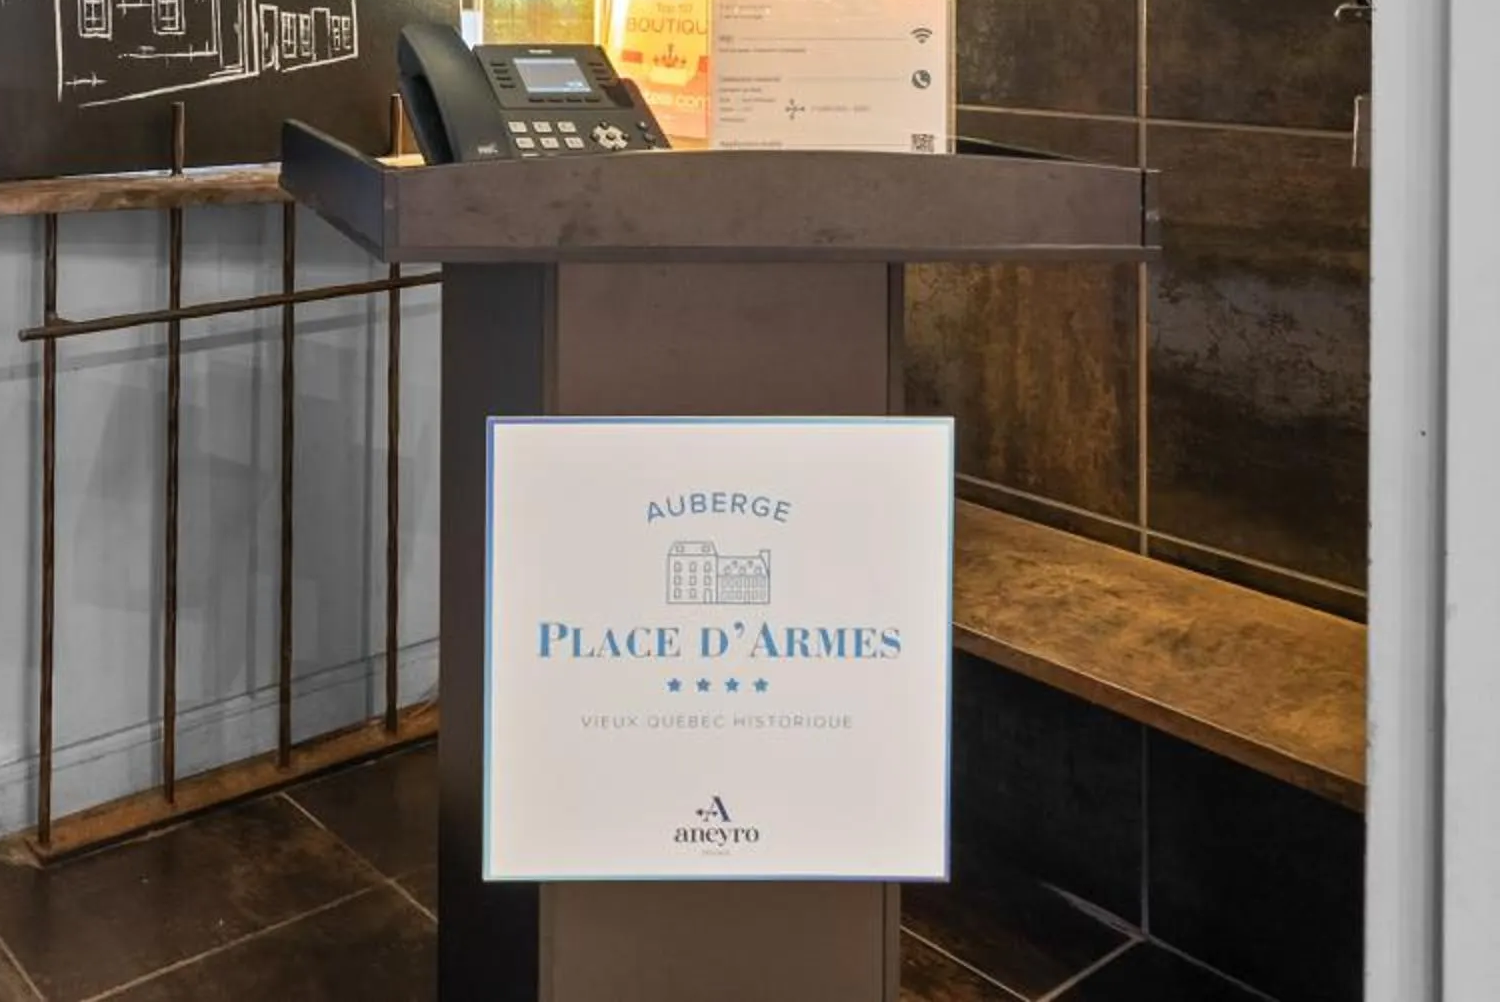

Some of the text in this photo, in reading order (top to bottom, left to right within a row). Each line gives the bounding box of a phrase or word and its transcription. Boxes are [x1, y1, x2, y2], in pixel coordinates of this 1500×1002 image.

[647, 492, 792, 523] AUBERGE
[539, 622, 681, 658] PLACE
[580, 714, 639, 729] VIEUX
[732, 713, 854, 729] HISTORIQUE
